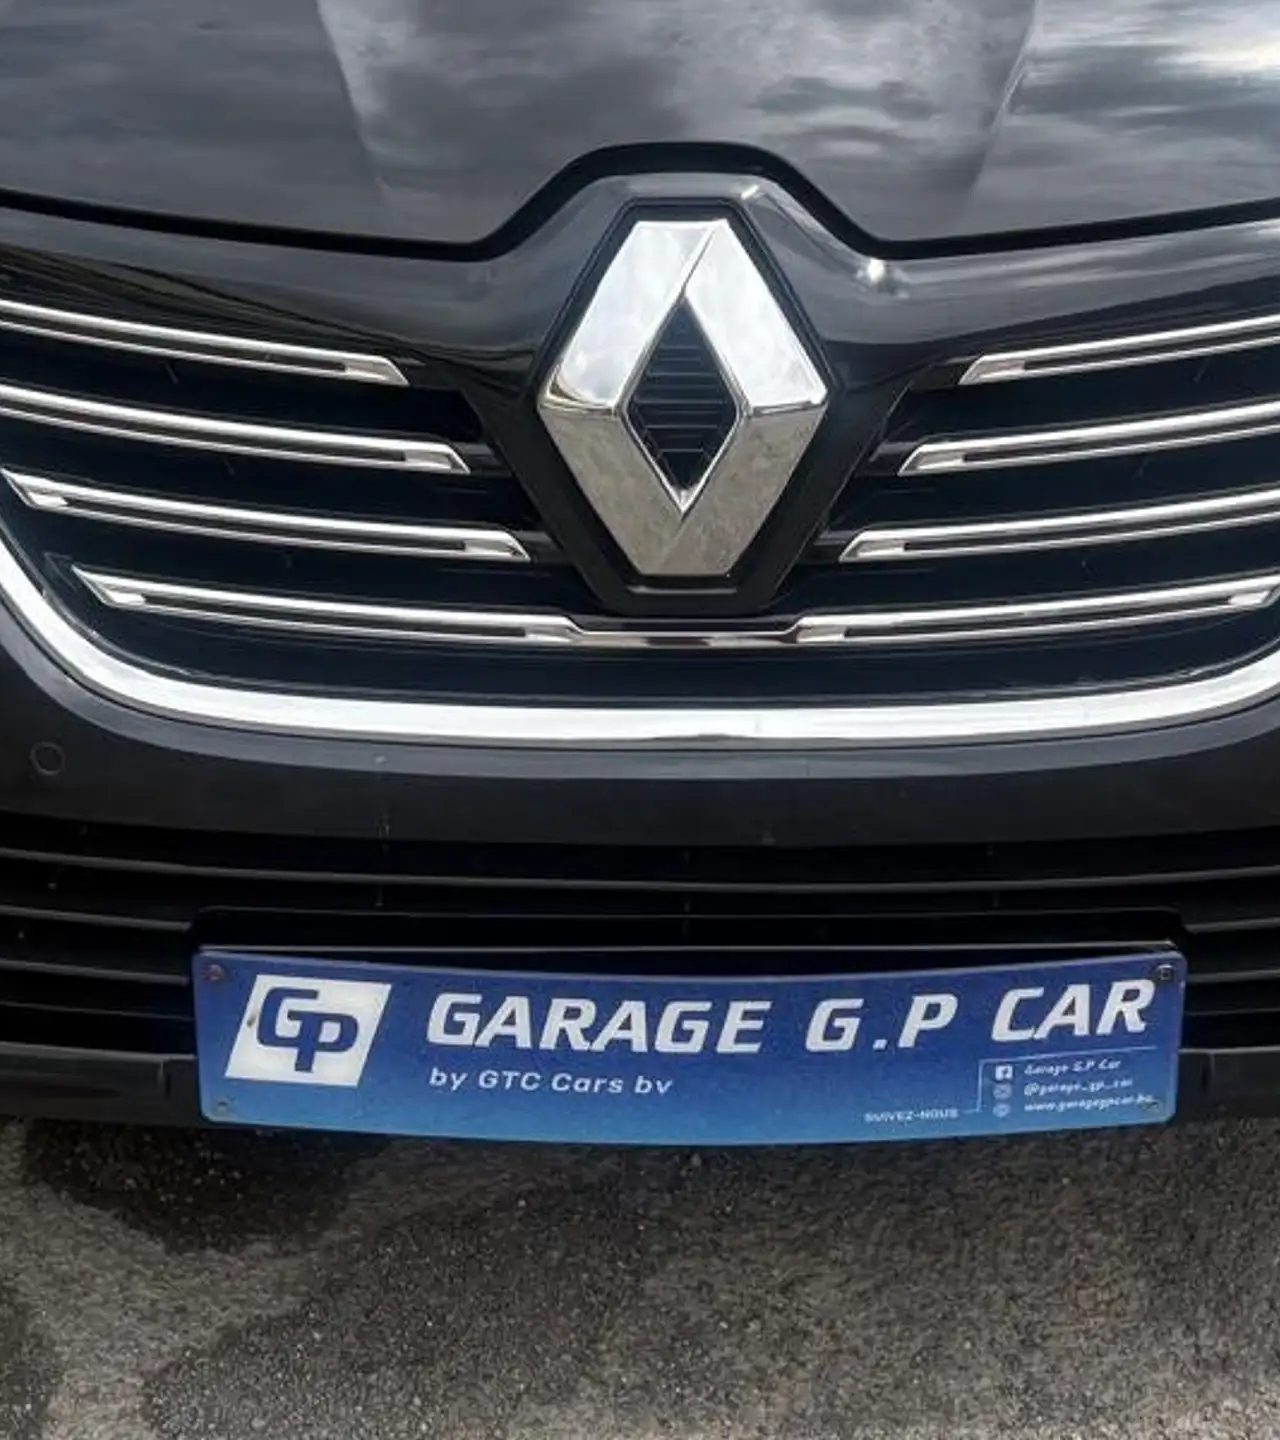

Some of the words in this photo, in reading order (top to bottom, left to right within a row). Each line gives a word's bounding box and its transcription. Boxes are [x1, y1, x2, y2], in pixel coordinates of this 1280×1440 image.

[425, 991, 773, 1055] GARAGE
[804, 993, 958, 1053] G.P
[990, 978, 1155, 1042] CAR
[428, 1066, 469, 1092] by
[478, 1069, 541, 1092] GTC
[552, 1072, 624, 1095] Cars
[634, 1074, 674, 1095] bv
[863, 1108, 958, 1124] SUIVEZ-NOUS
